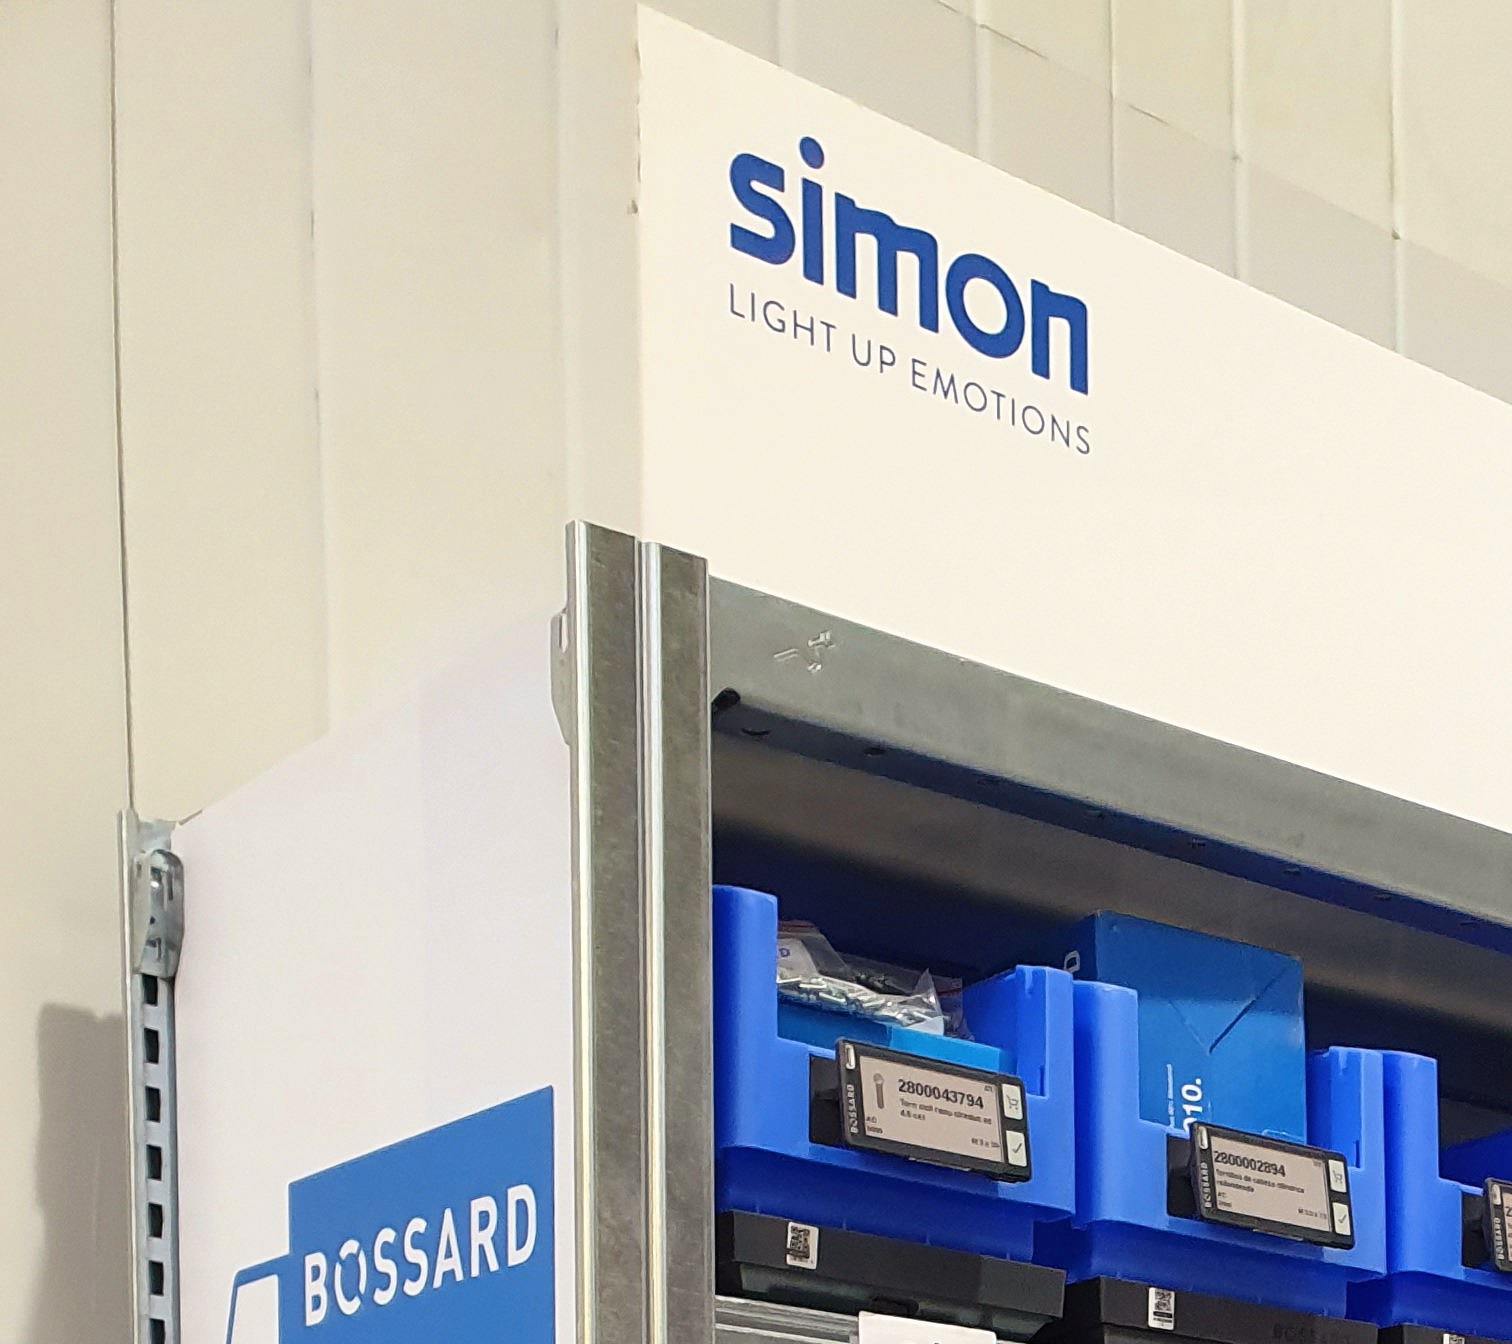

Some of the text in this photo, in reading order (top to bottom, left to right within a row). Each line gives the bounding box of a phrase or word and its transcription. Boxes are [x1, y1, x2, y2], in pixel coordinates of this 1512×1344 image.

[729, 136, 1088, 396] simon
[729, 283, 1091, 456] LIGHT UP EMOTIONS
[847, 1084, 859, 1134] BOSSARD
[898, 1079, 983, 1110] 2800043794
[305, 1184, 536, 1327] BOSSARD
